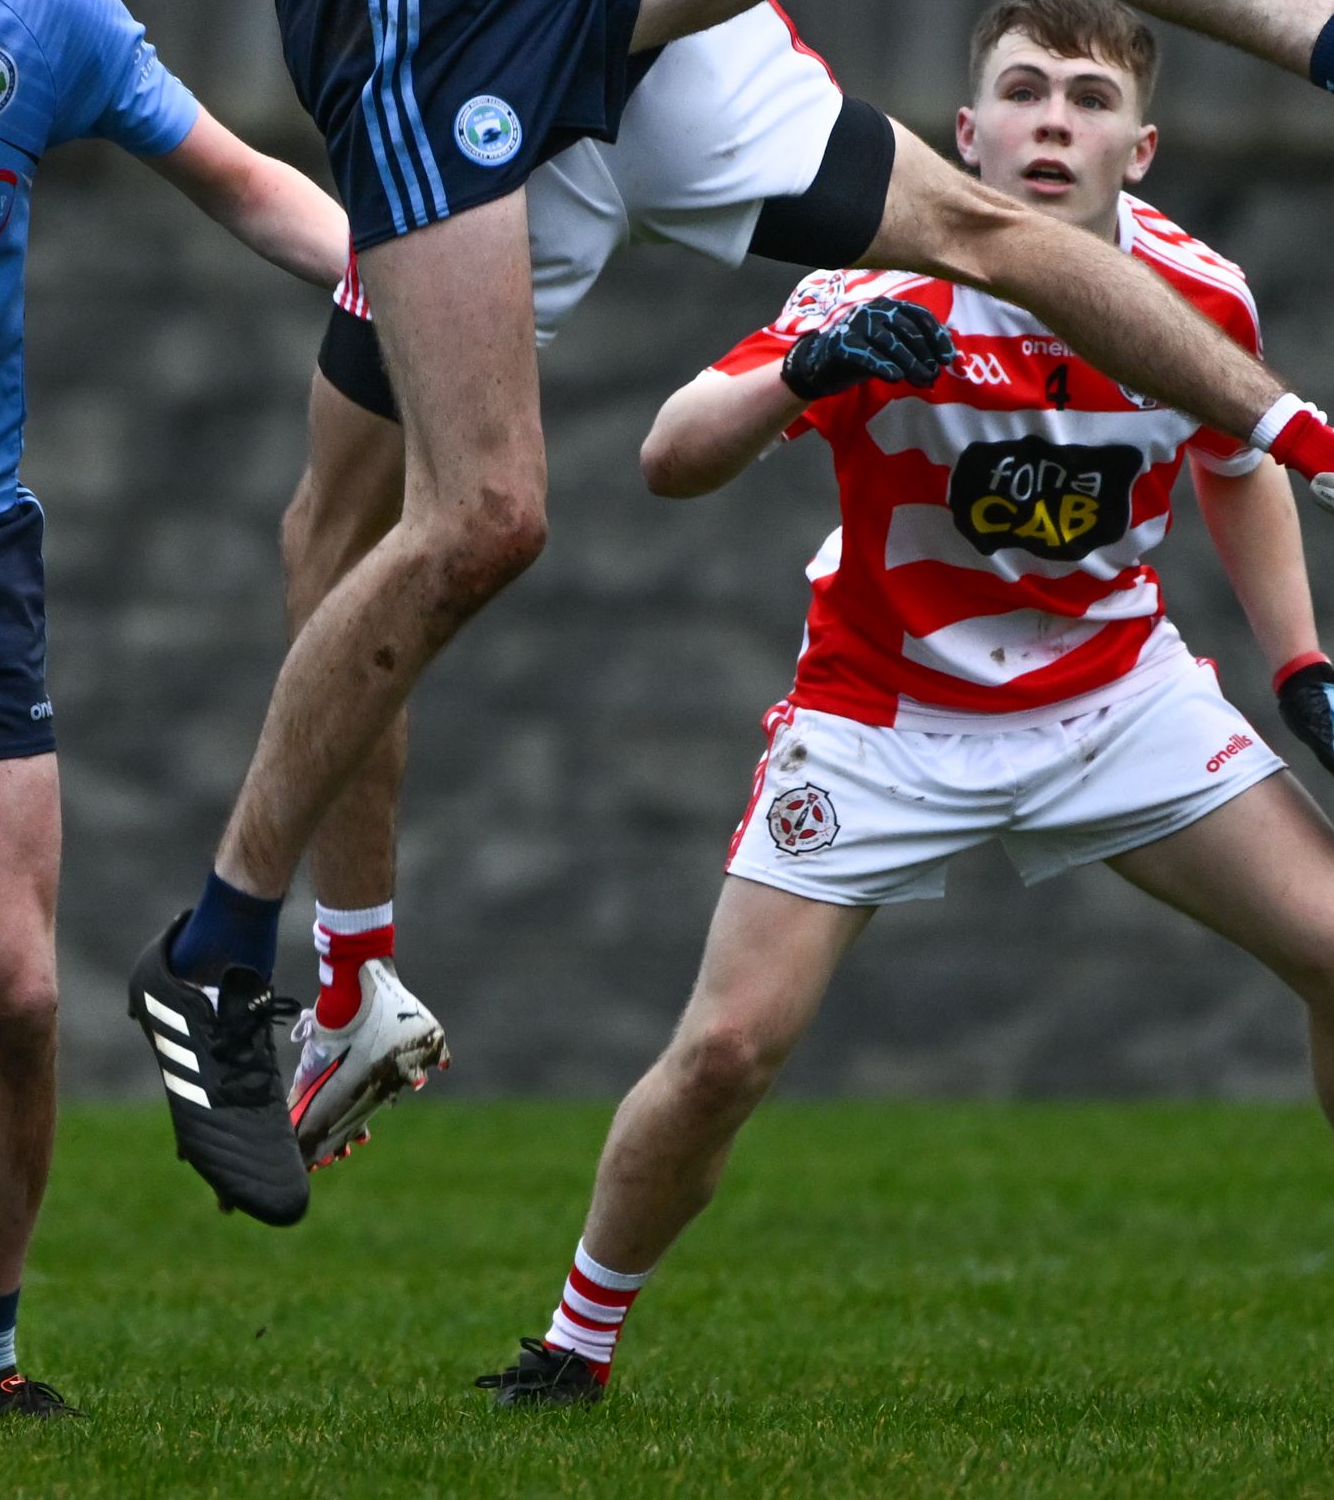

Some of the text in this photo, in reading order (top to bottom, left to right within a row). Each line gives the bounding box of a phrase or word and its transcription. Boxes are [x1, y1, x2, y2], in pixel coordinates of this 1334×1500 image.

[1045, 364, 1071, 411] 4
[989, 456, 1102, 501] fona
[971, 494, 1100, 547] CAB
